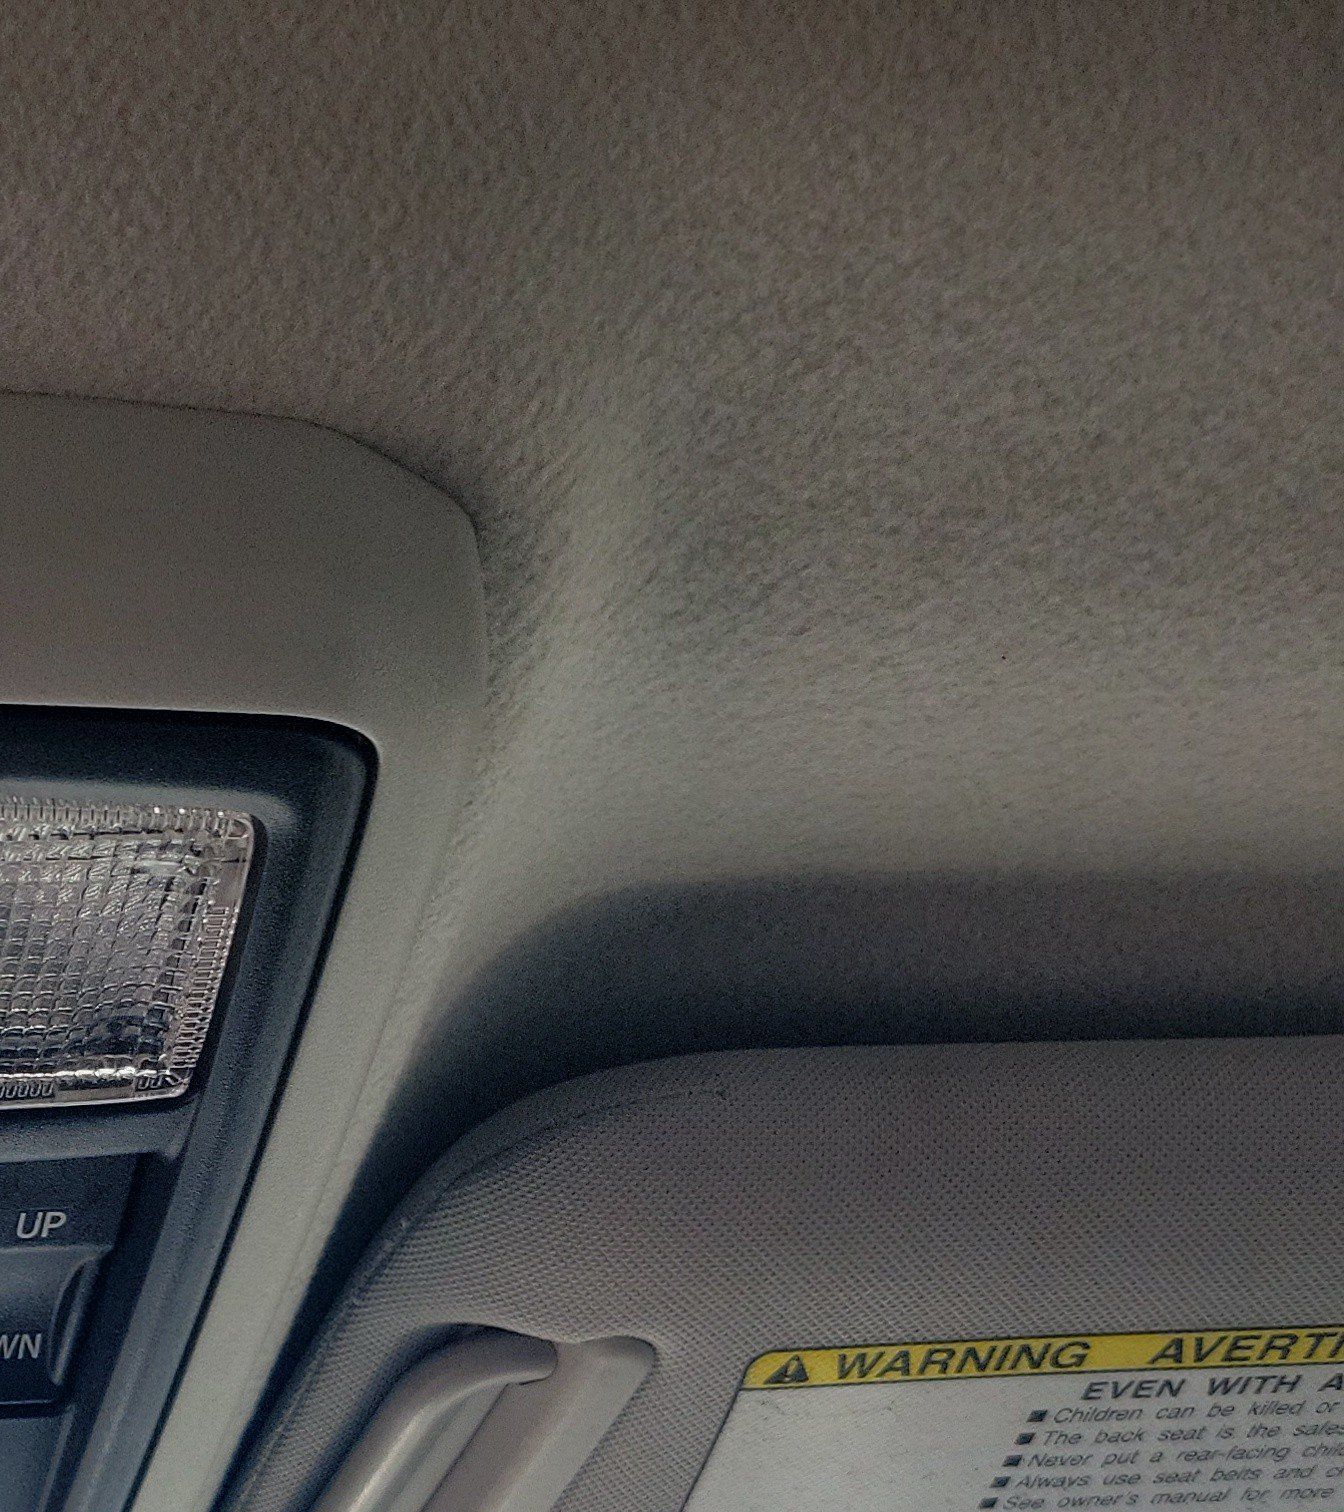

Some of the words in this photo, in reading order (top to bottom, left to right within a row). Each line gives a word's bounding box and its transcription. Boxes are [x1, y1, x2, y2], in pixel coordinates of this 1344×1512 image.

[16, 1211, 67, 1239] UP
[836, 1340, 1092, 1380] WARNING
[1081, 1378, 1188, 1401] EVEN
[1207, 1374, 1304, 1397] WITH
[1053, 1406, 1143, 1424] Children
[1155, 1405, 1195, 1420] can
[1207, 1402, 1235, 1418] be
[1247, 1399, 1306, 1416] killed
[1315, 1401, 1341, 1414] or
[1043, 1430, 1083, 1446] The
[1095, 1428, 1146, 1444] back
[1157, 1426, 1207, 1441] seat
[1215, 1424, 1234, 1440] is
[1246, 1421, 1281, 1438] the
[1027, 1451, 1093, 1467] Never
[1100, 1449, 1139, 1468] put
[1148, 1451, 1164, 1464] a
[1174, 1443, 1292, 1463] rear-facing
[1015, 1473, 1090, 1492] Always
[1102, 1472, 1142, 1487] use
[1152, 1469, 1201, 1485] seat
[1209, 1465, 1263, 1483] belts
[1272, 1464, 1319, 1480] and
[1002, 1493, 1046, 1510] See
[1060, 1490, 1139, 1508] owner's
[1149, 1487, 1232, 1505] manual
[1241, 1485, 1271, 1502] for
[1279, 1487, 1334, 1501] more
